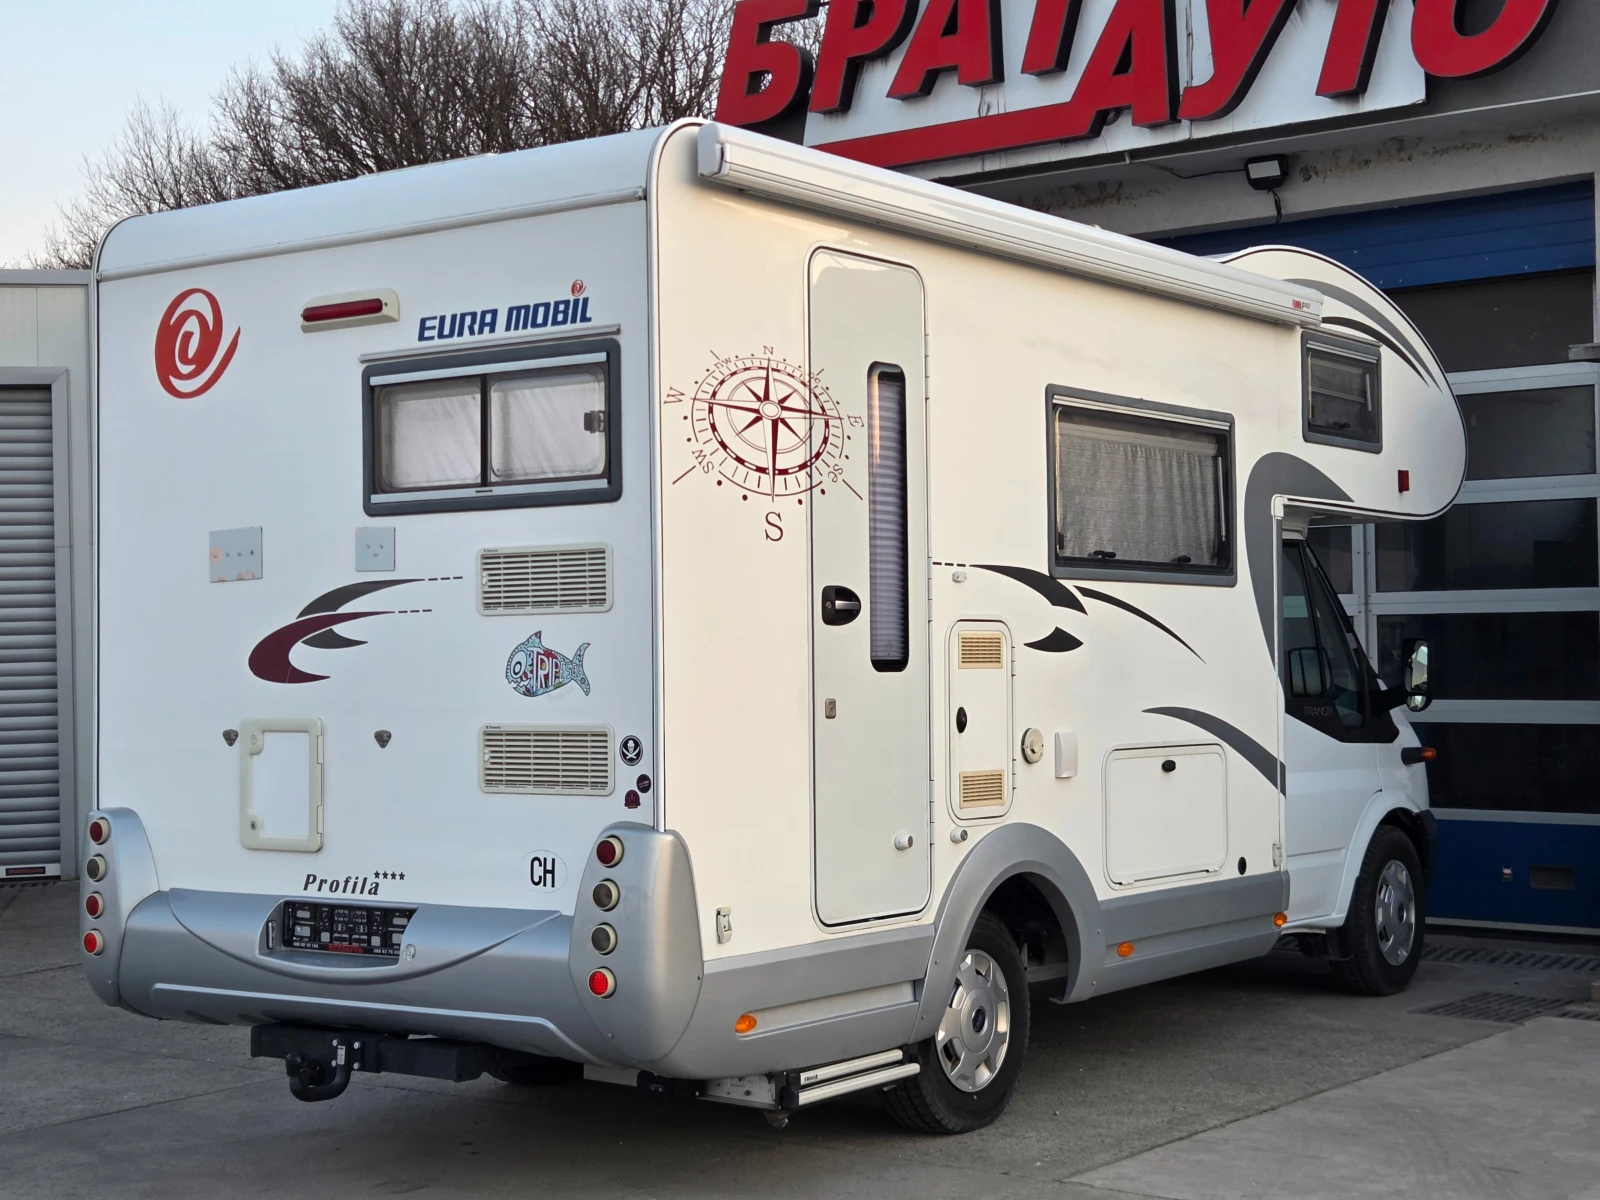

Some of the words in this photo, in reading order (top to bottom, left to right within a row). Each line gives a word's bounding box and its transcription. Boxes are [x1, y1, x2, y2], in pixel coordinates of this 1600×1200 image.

[417, 308, 499, 342] EURA
[504, 296, 592, 332] MOBIL
[762, 345, 775, 355] N
[664, 386, 686, 405] W
[847, 414, 865, 428] E
[764, 511, 784, 542] S
[1303, 706, 1333, 717] TRANSIT
[530, 856, 556, 888] CH
[303, 873, 380, 896] Profila
